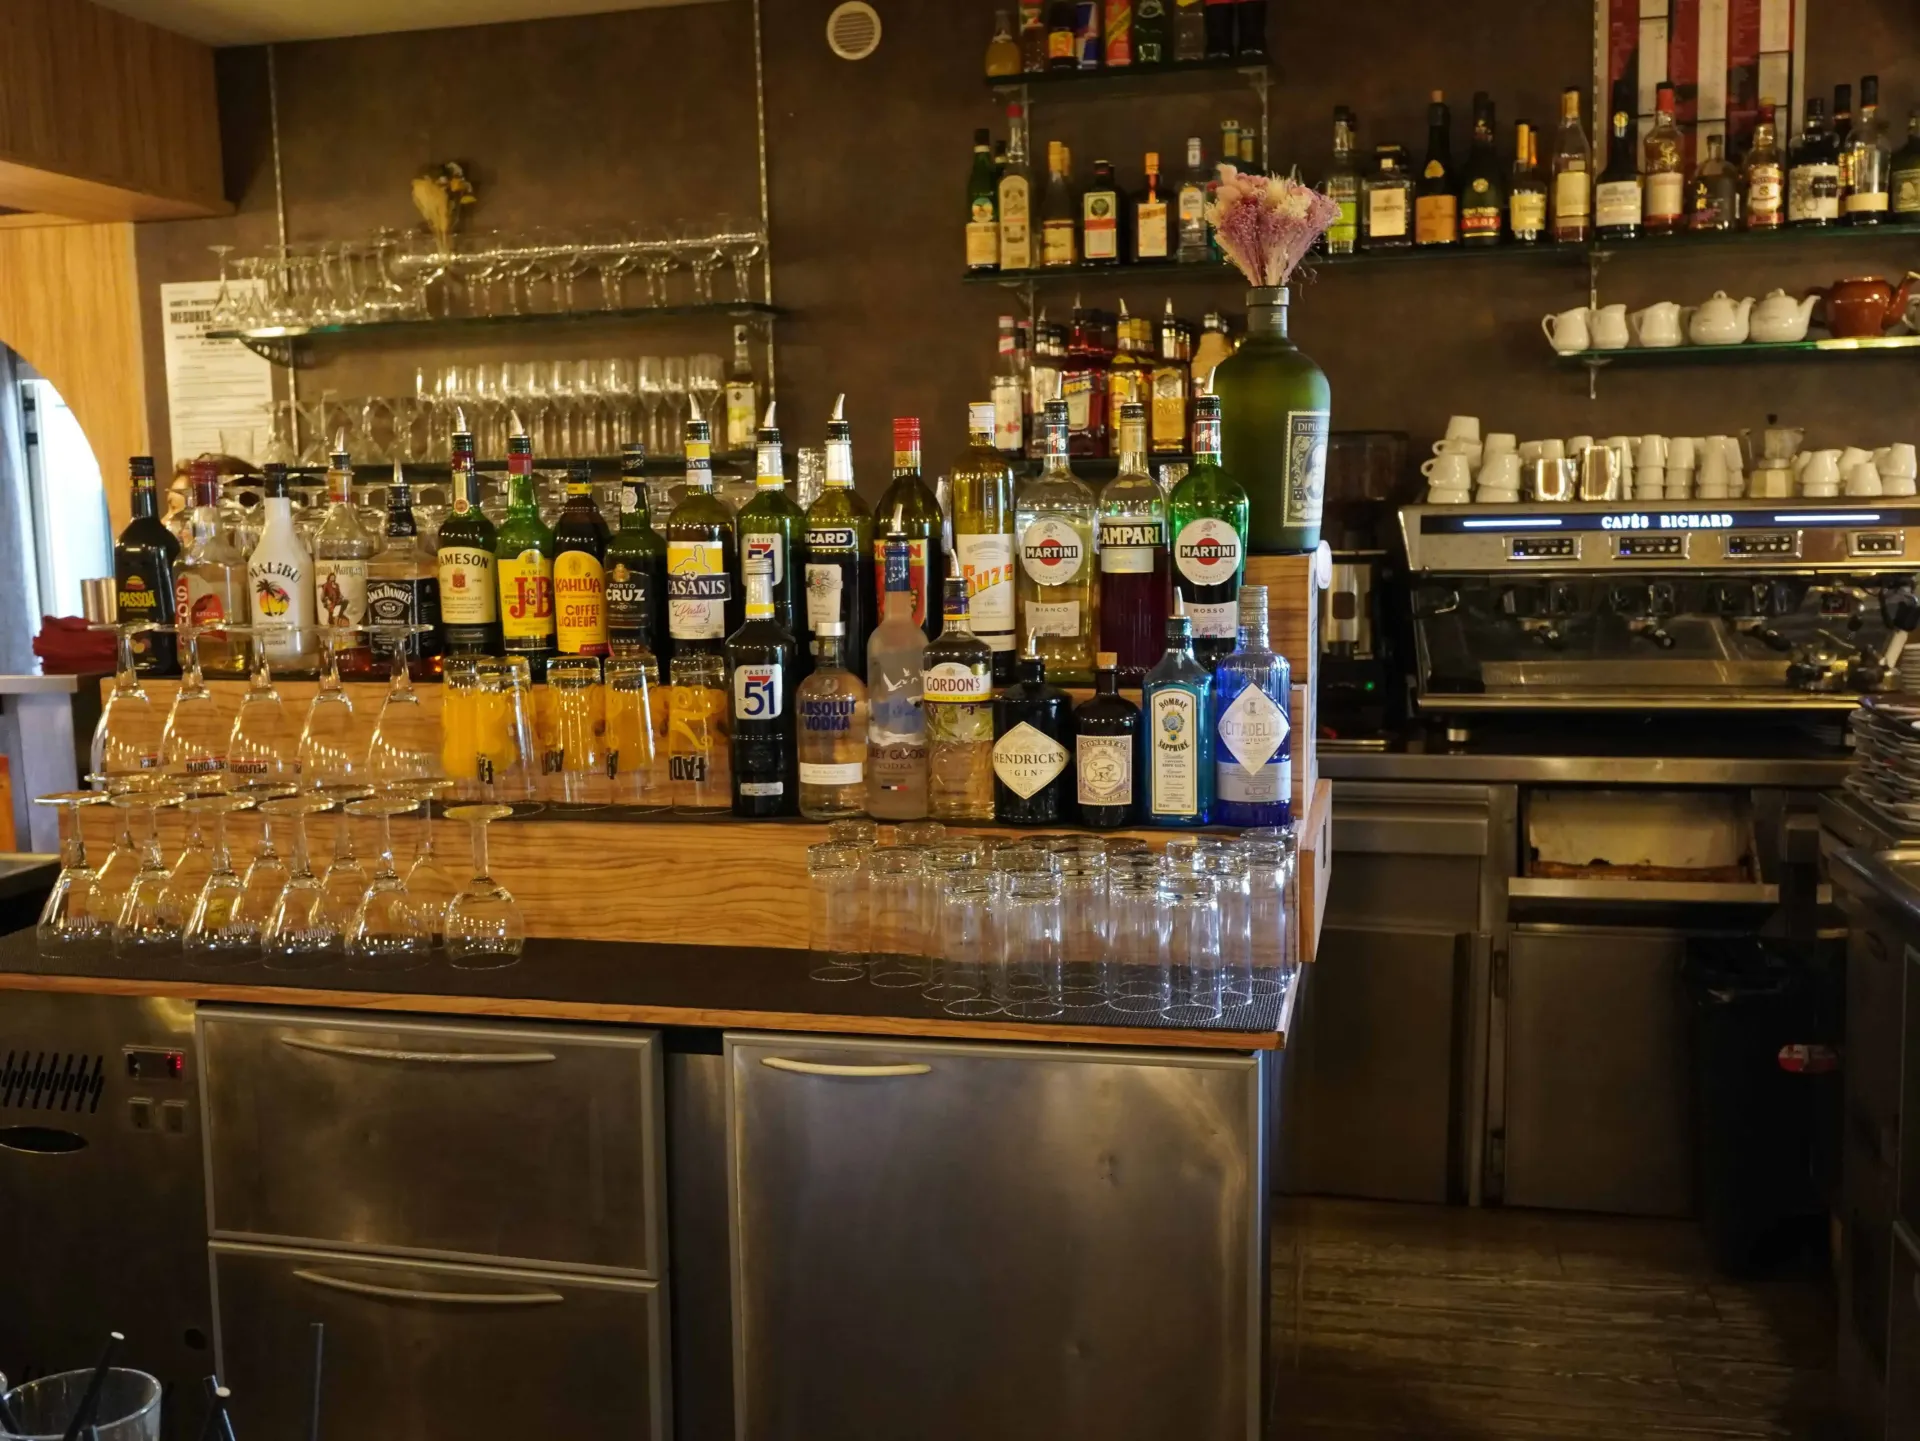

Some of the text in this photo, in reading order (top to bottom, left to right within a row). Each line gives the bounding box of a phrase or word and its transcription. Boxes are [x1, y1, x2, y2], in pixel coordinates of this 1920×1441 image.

[1660, 514, 1733, 528] RICHARD
[1100, 526, 1159, 545] AMPARI
[1026, 547, 1078, 558] MARTINI
[1182, 546, 1235, 557] MARTINI
[606, 589, 645, 601] CRUZ
[565, 604, 600, 616] COFFEE
[926, 677, 980, 692] GORDON'S
[743, 681, 776, 716] 51
[1158, 698, 1188, 711] BOMBAY
[801, 701, 856, 716] ABSOLUT
[804, 716, 850, 731] VODKA
[1158, 739, 1190, 752] SAPPHIRE
[994, 751, 1065, 765] HENDRICK'S
[1014, 768, 1038, 776] GIN
